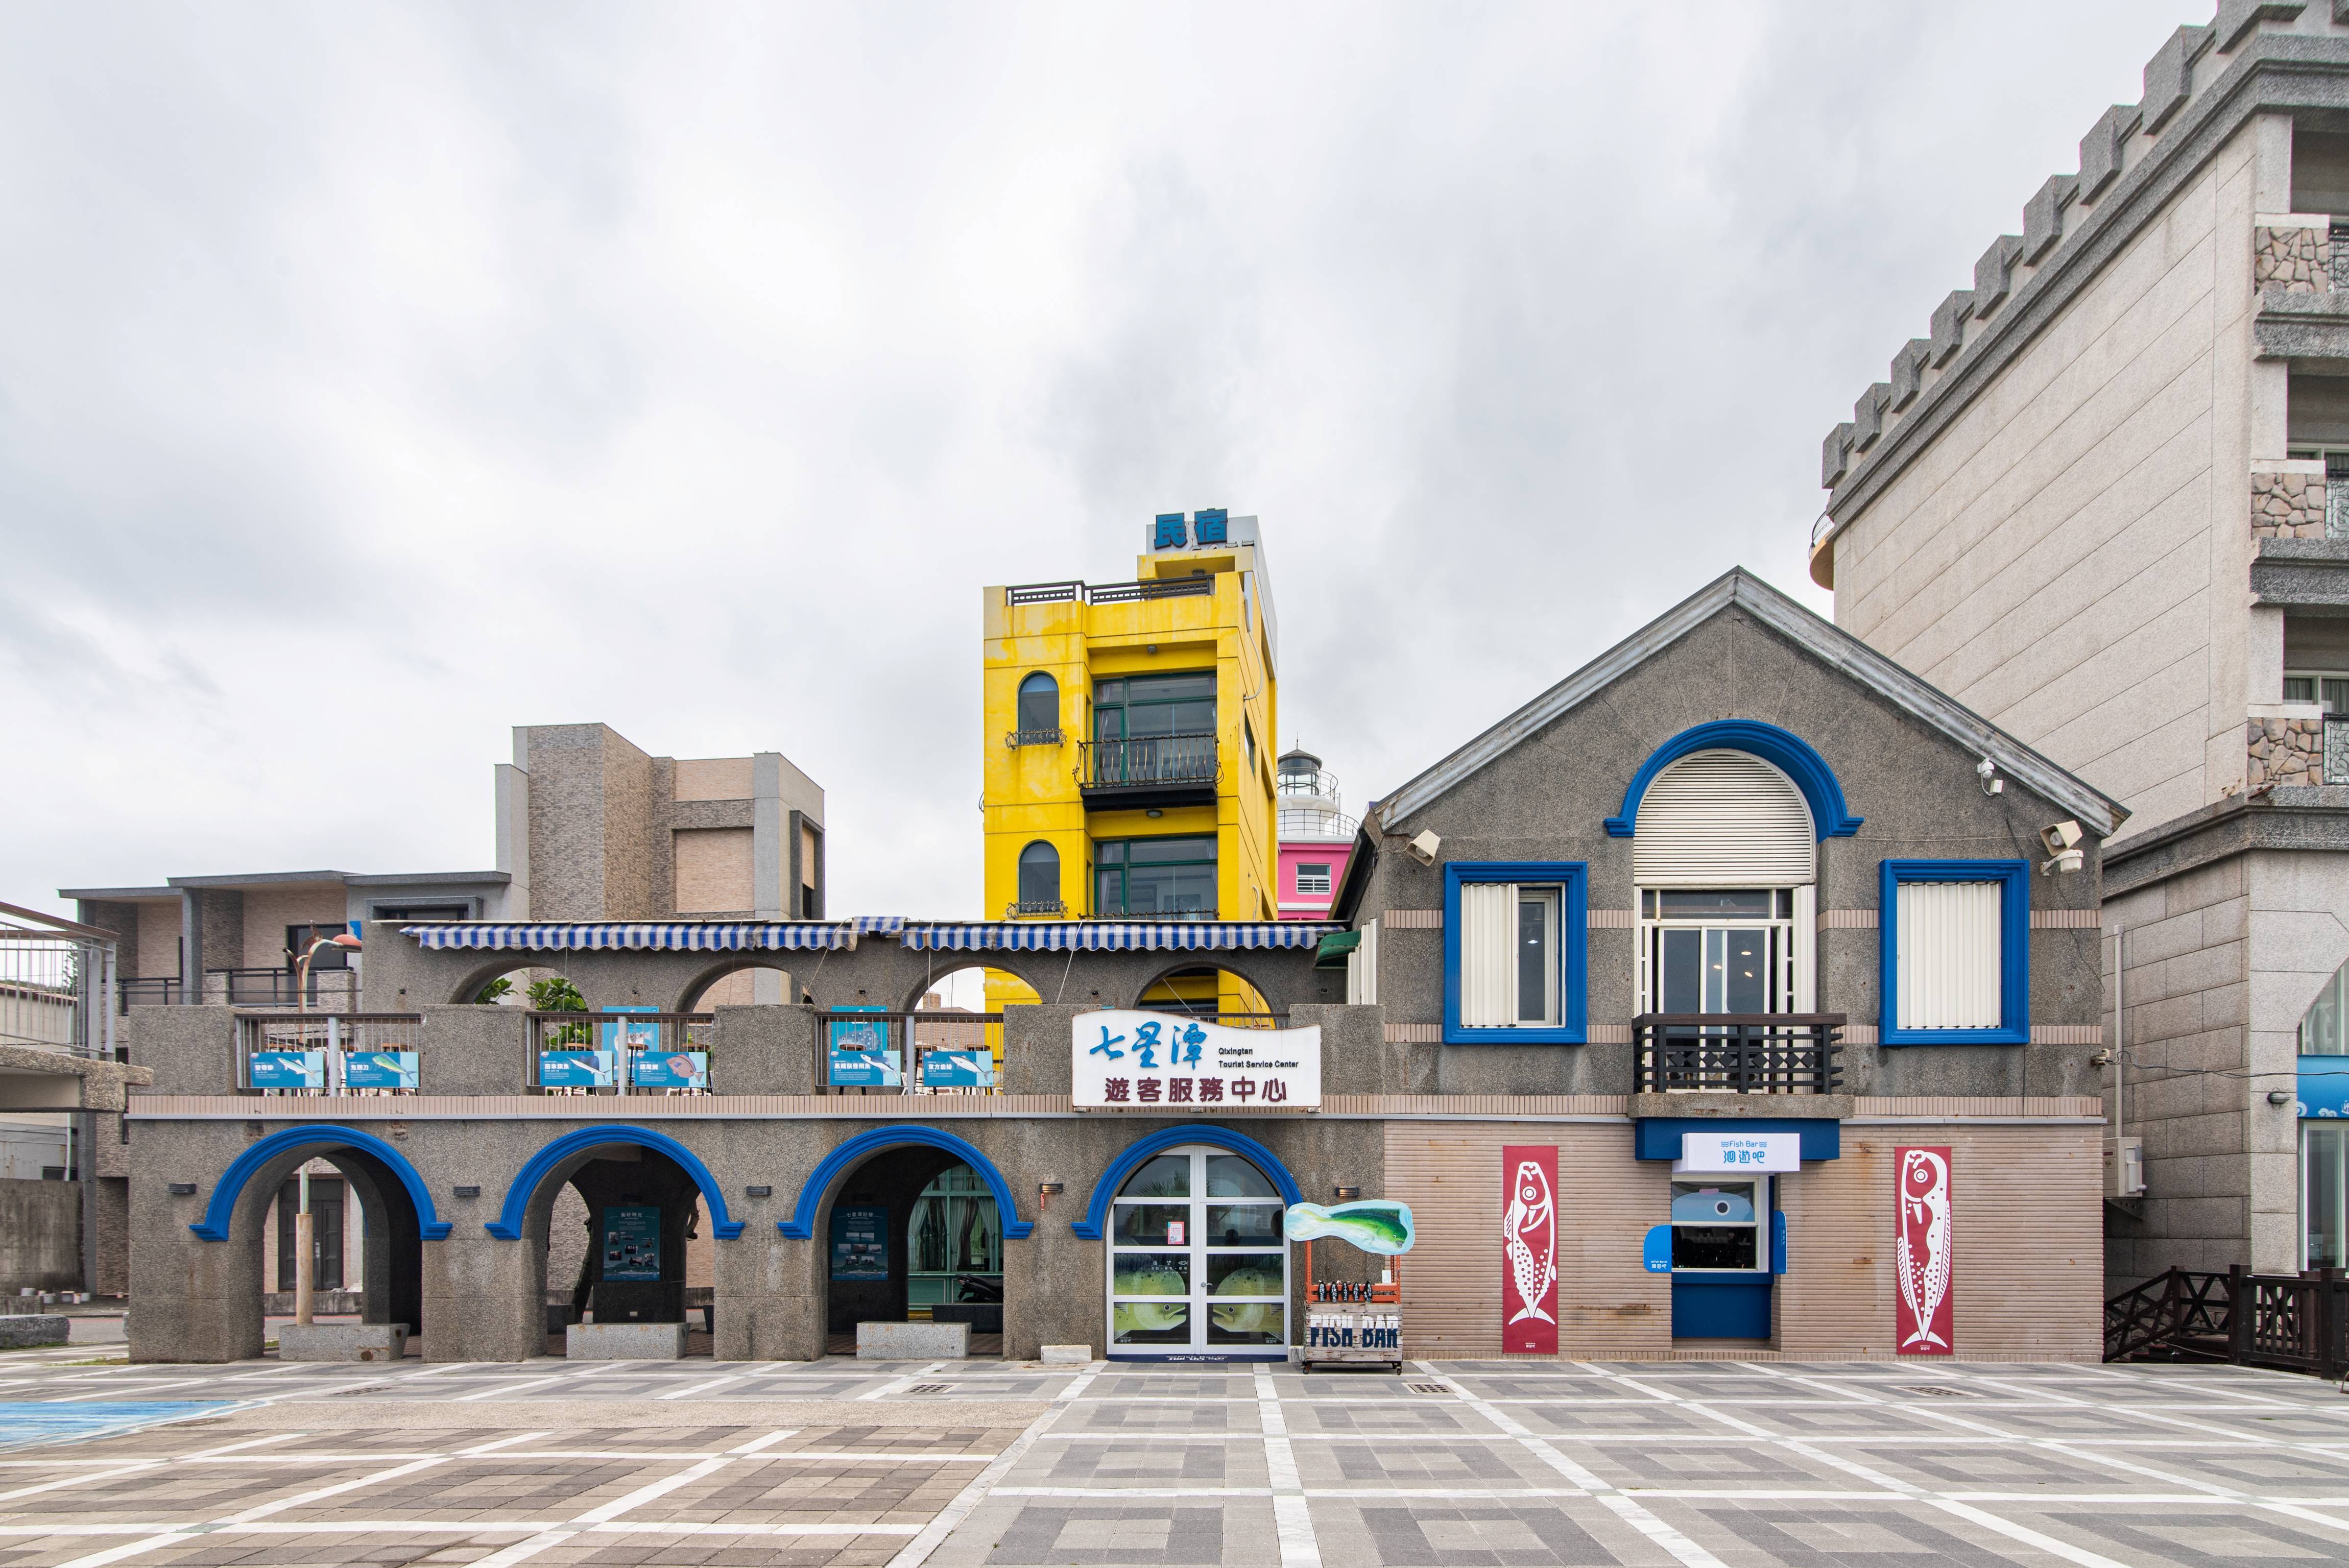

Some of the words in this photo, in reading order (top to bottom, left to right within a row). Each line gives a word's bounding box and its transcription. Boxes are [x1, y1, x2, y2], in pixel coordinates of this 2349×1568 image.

[1154, 508, 1228, 550] 民宿
[1089, 1021, 1207, 1070] 七星潭
[1218, 1047, 1253, 1056] Qixingtan
[1246, 1060, 1273, 1068] Service
[1275, 1060, 1299, 1068] Center
[1105, 1076, 1287, 1102] 遊客服務中心
[1723, 1150, 1765, 1164] 洄遊吧
[1310, 1315, 1353, 1347] FISH
[1362, 1315, 1398, 1348] BAR
